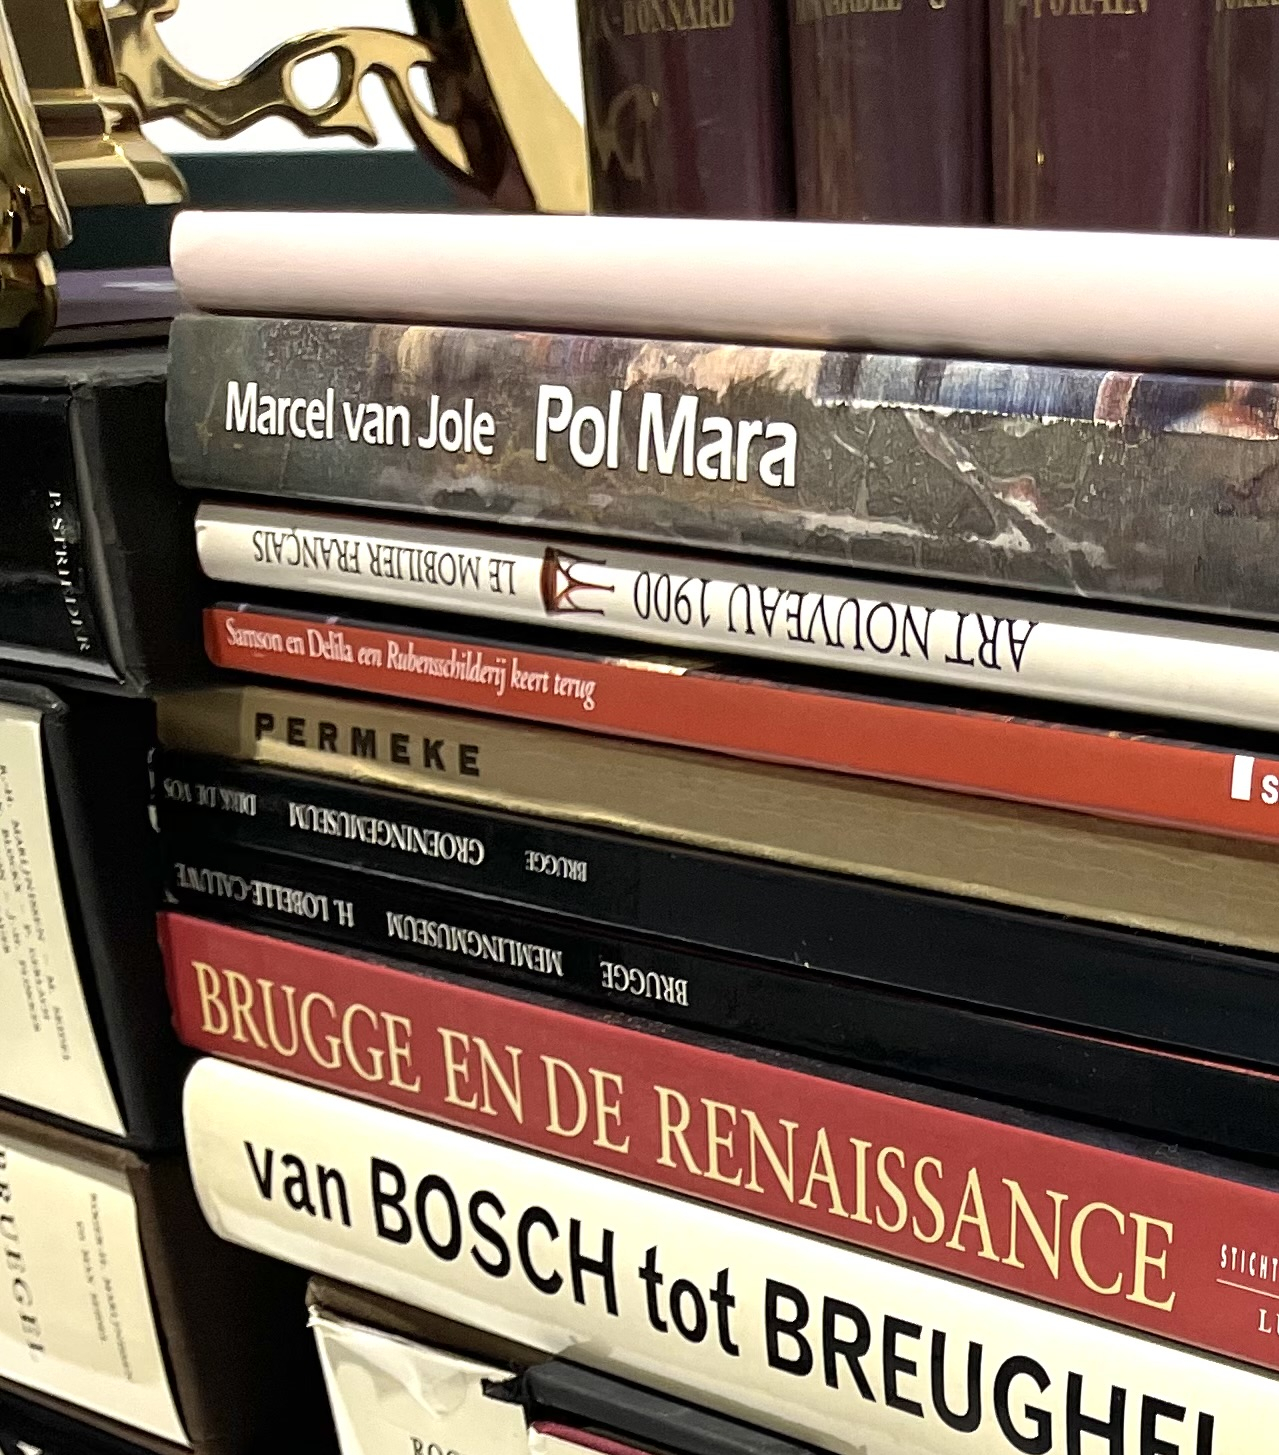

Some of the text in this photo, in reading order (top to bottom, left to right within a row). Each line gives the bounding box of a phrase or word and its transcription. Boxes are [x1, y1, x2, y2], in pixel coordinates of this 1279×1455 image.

[225, 382, 797, 487] Marcel van Jole Pol Mara
[252, 527, 517, 594] LE MOBILIER FRANÇAIS
[634, 571, 1036, 673] ART NOUVEAU 1900
[225, 618, 596, 711] Samson en Delila een Rubensschilderij keert terug
[255, 711, 482, 777] PERMEKE
[197, 784, 216, 809] DE
[289, 802, 485, 867] GROENINGEMUSEUM
[525, 849, 588, 883] BRUGGE
[386, 911, 565, 978] MEMLINGMUSEUM
[599, 960, 690, 1007] BRUGGE
[191, 961, 421, 1093] BRUGGE
[437, 1026, 525, 1125] EN
[541, 1054, 632, 1155] DE
[652, 1085, 1176, 1313] RENAISSANCE
[244, 1140, 352, 1227] van
[370, 1155, 619, 1317] BOSCH
[638, 1245, 741, 1358] tot
